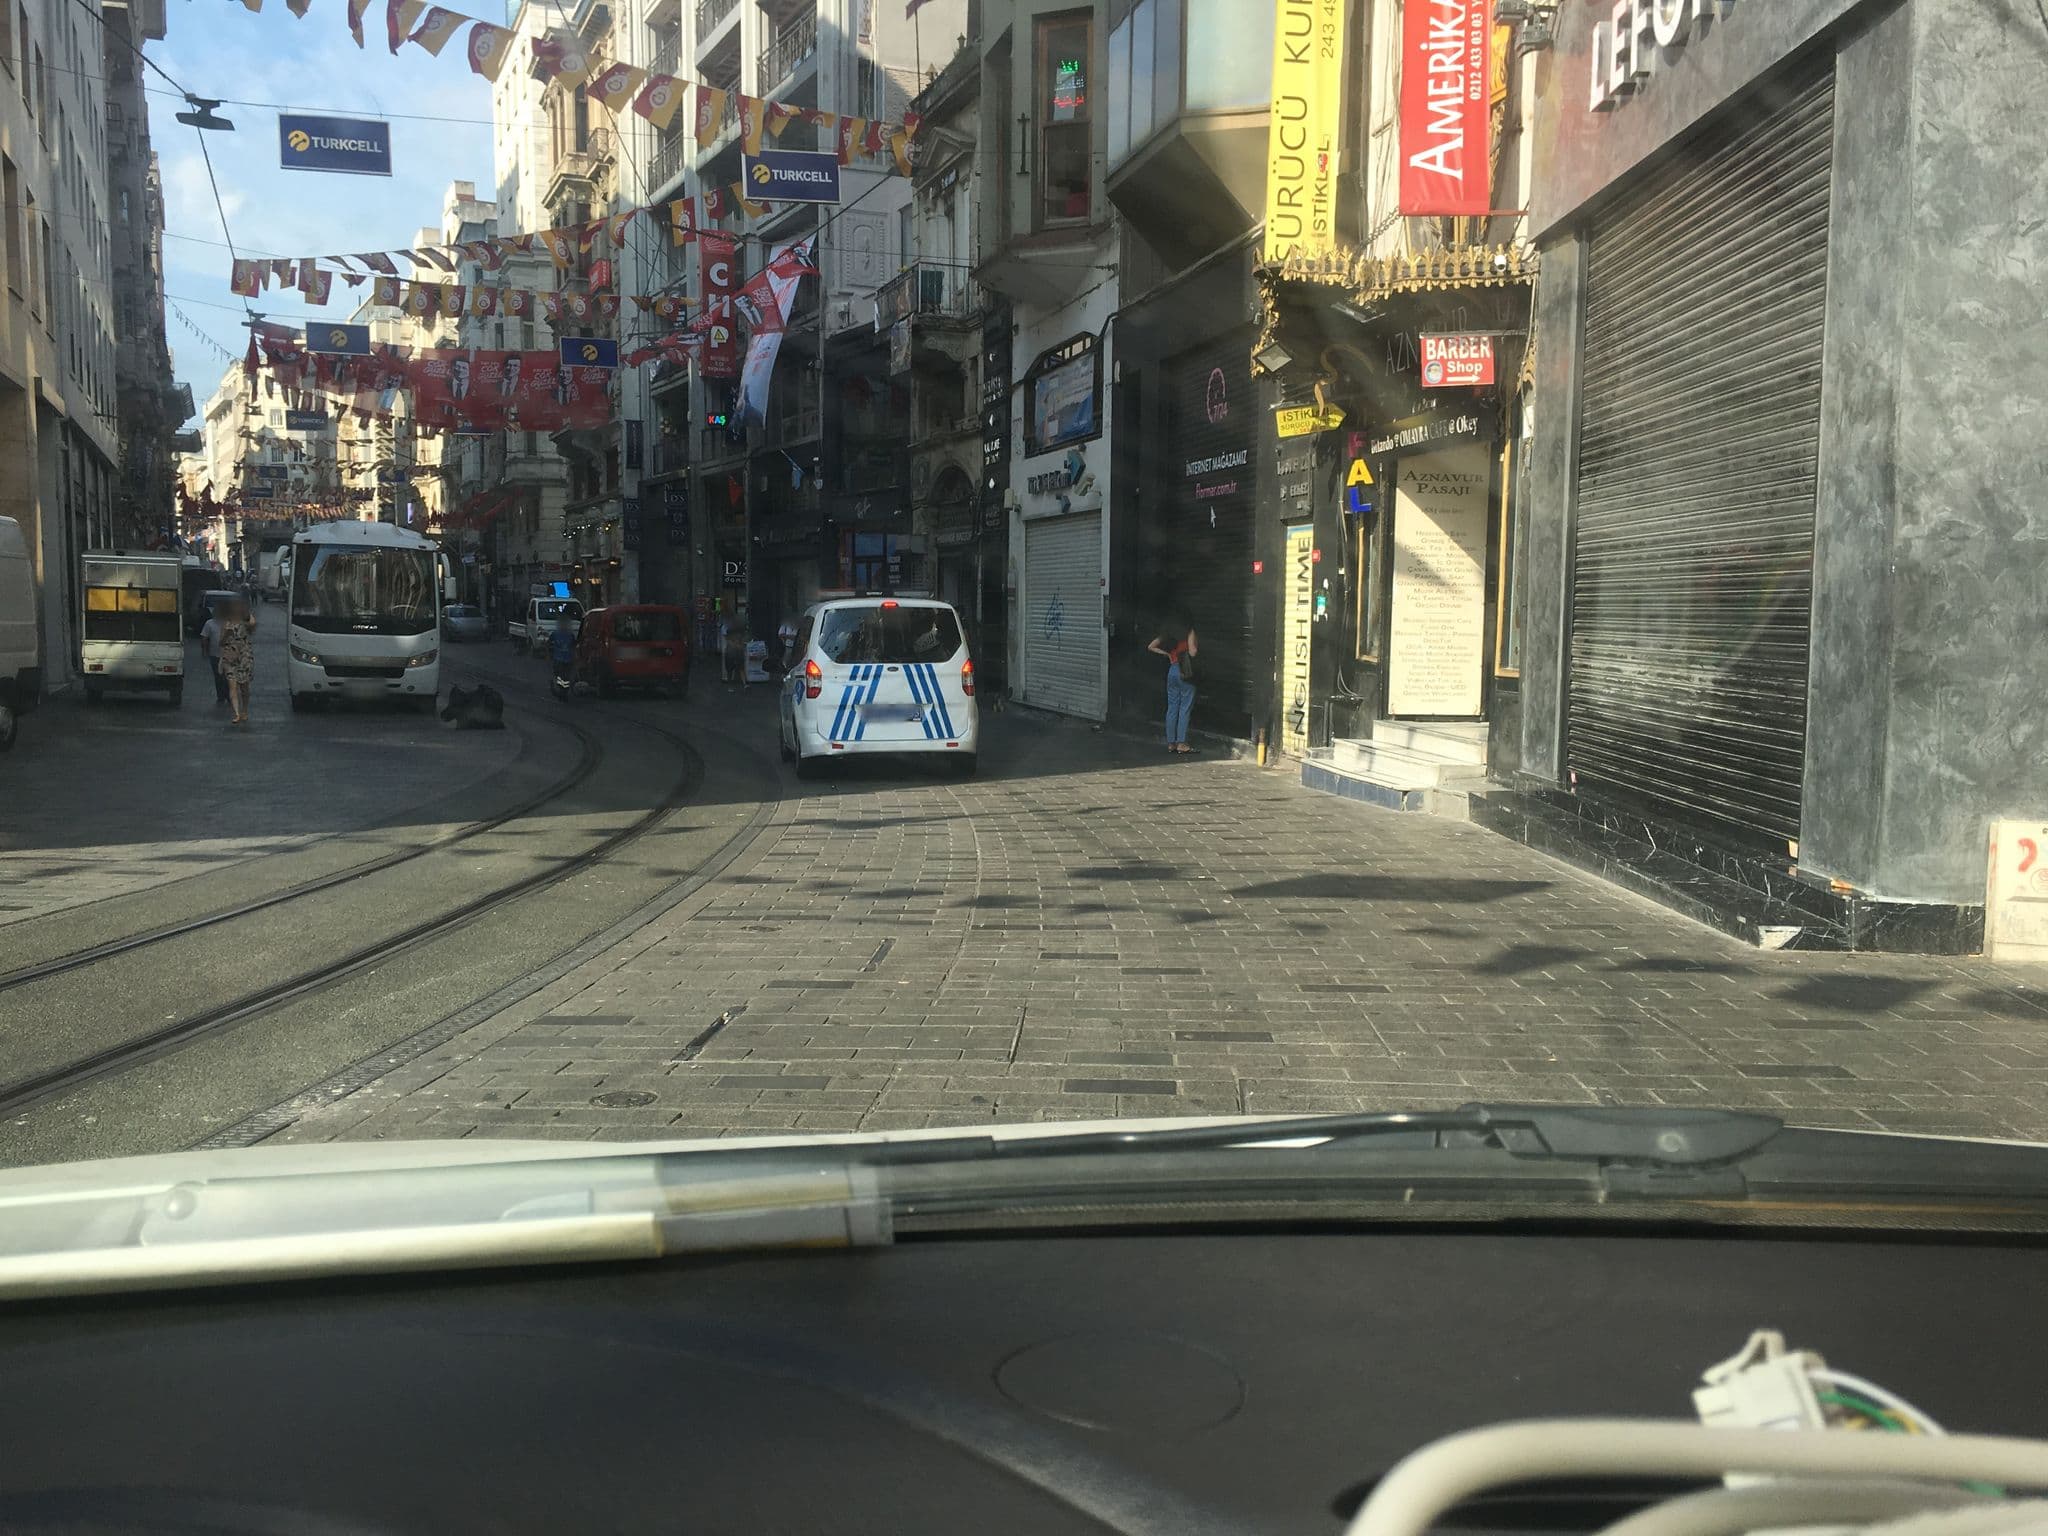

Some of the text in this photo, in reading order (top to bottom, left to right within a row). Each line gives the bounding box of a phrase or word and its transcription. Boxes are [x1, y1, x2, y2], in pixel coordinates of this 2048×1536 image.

[1471, 12, 1484, 27] 03
[1321, 23, 1336, 59] 243
[1470, 31, 1483, 46] 03
[1470, 47, 1483, 69] 433
[1590, 0, 1712, 113] LEFO
[1469, 71, 1483, 100] 0212
[311, 136, 383, 154] TURKCELL
[772, 169, 833, 183] TURKCELL
[1426, 336, 1491, 360] BARBER
[1446, 360, 1483, 376] Shop
[708, 415, 727, 426] KAŞ
[1429, 419, 1449, 439] CAFE
[1456, 415, 1479, 435] Okey
[1185, 449, 1248, 476] İNTERNET MAĞAZAMIZ
[1405, 470, 1484, 483] AZNAVUR
[1416, 482, 1471, 497] PASAJI
[1292, 536, 1311, 752] ENGLISH TIME
